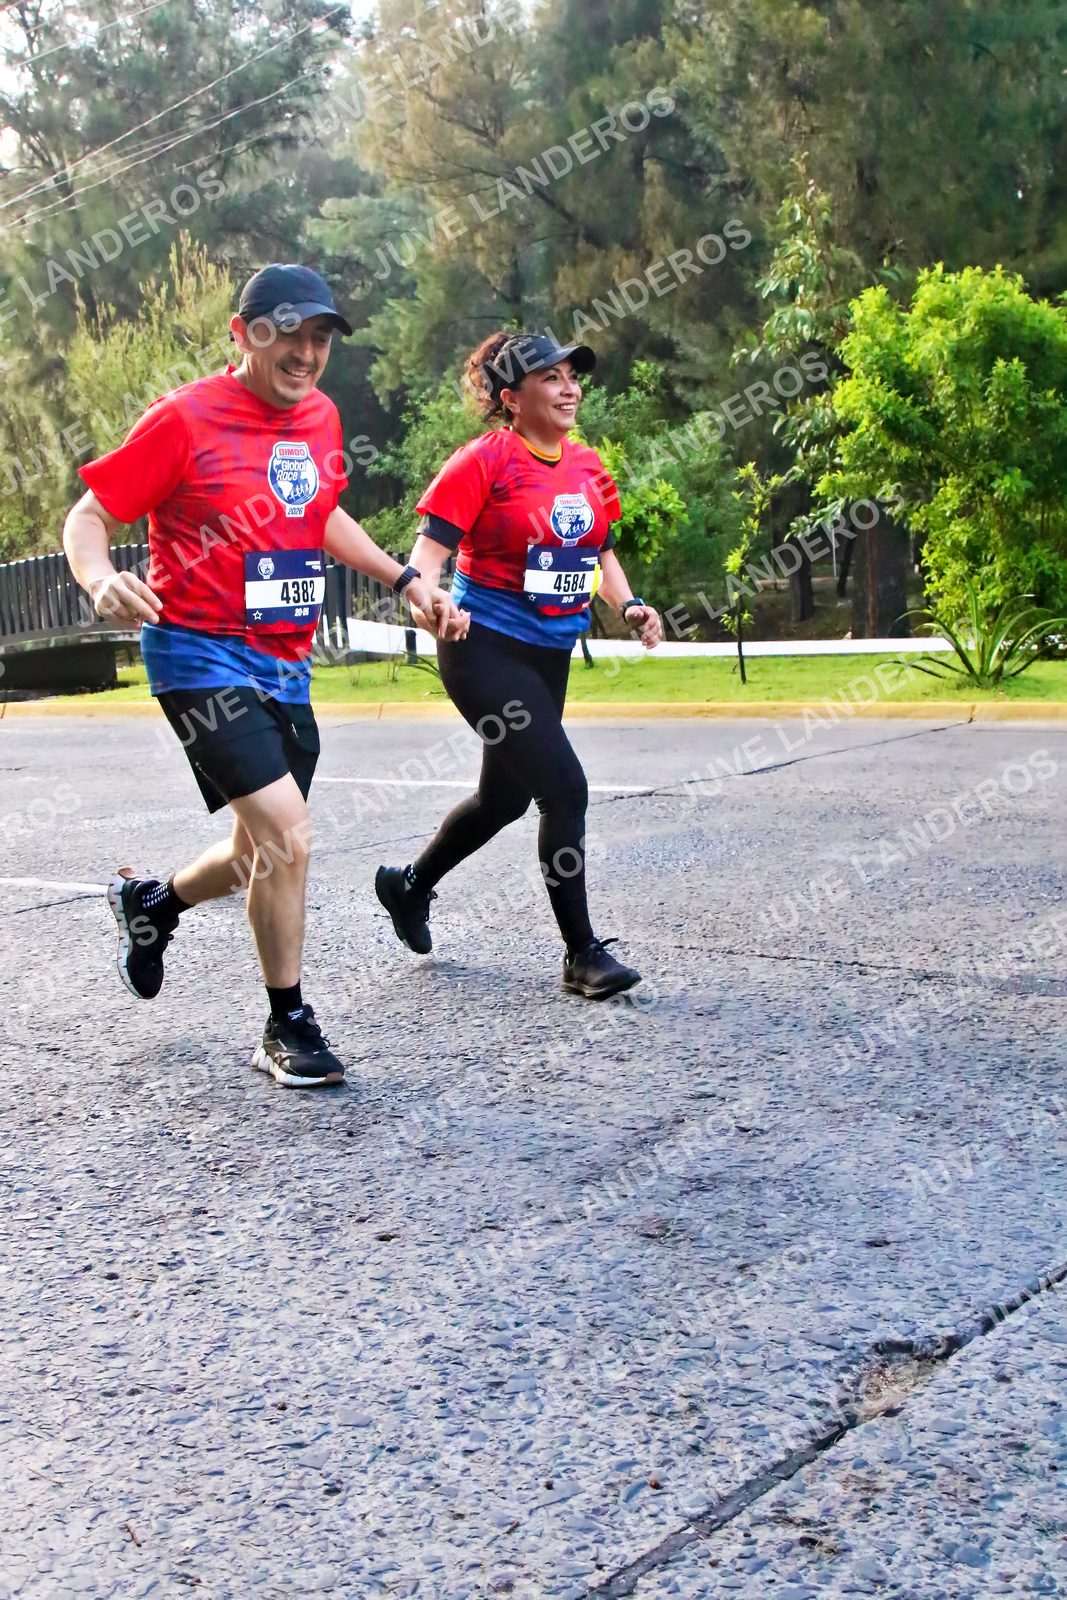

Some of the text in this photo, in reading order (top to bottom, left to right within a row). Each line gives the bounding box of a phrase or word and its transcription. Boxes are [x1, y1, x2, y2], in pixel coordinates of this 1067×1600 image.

[279, 448, 306, 456] BIMBO
[281, 460, 306, 472] Global
[276, 470, 298, 481] Race
[553, 573, 587, 593] 4584
[281, 580, 316, 605] 4382
